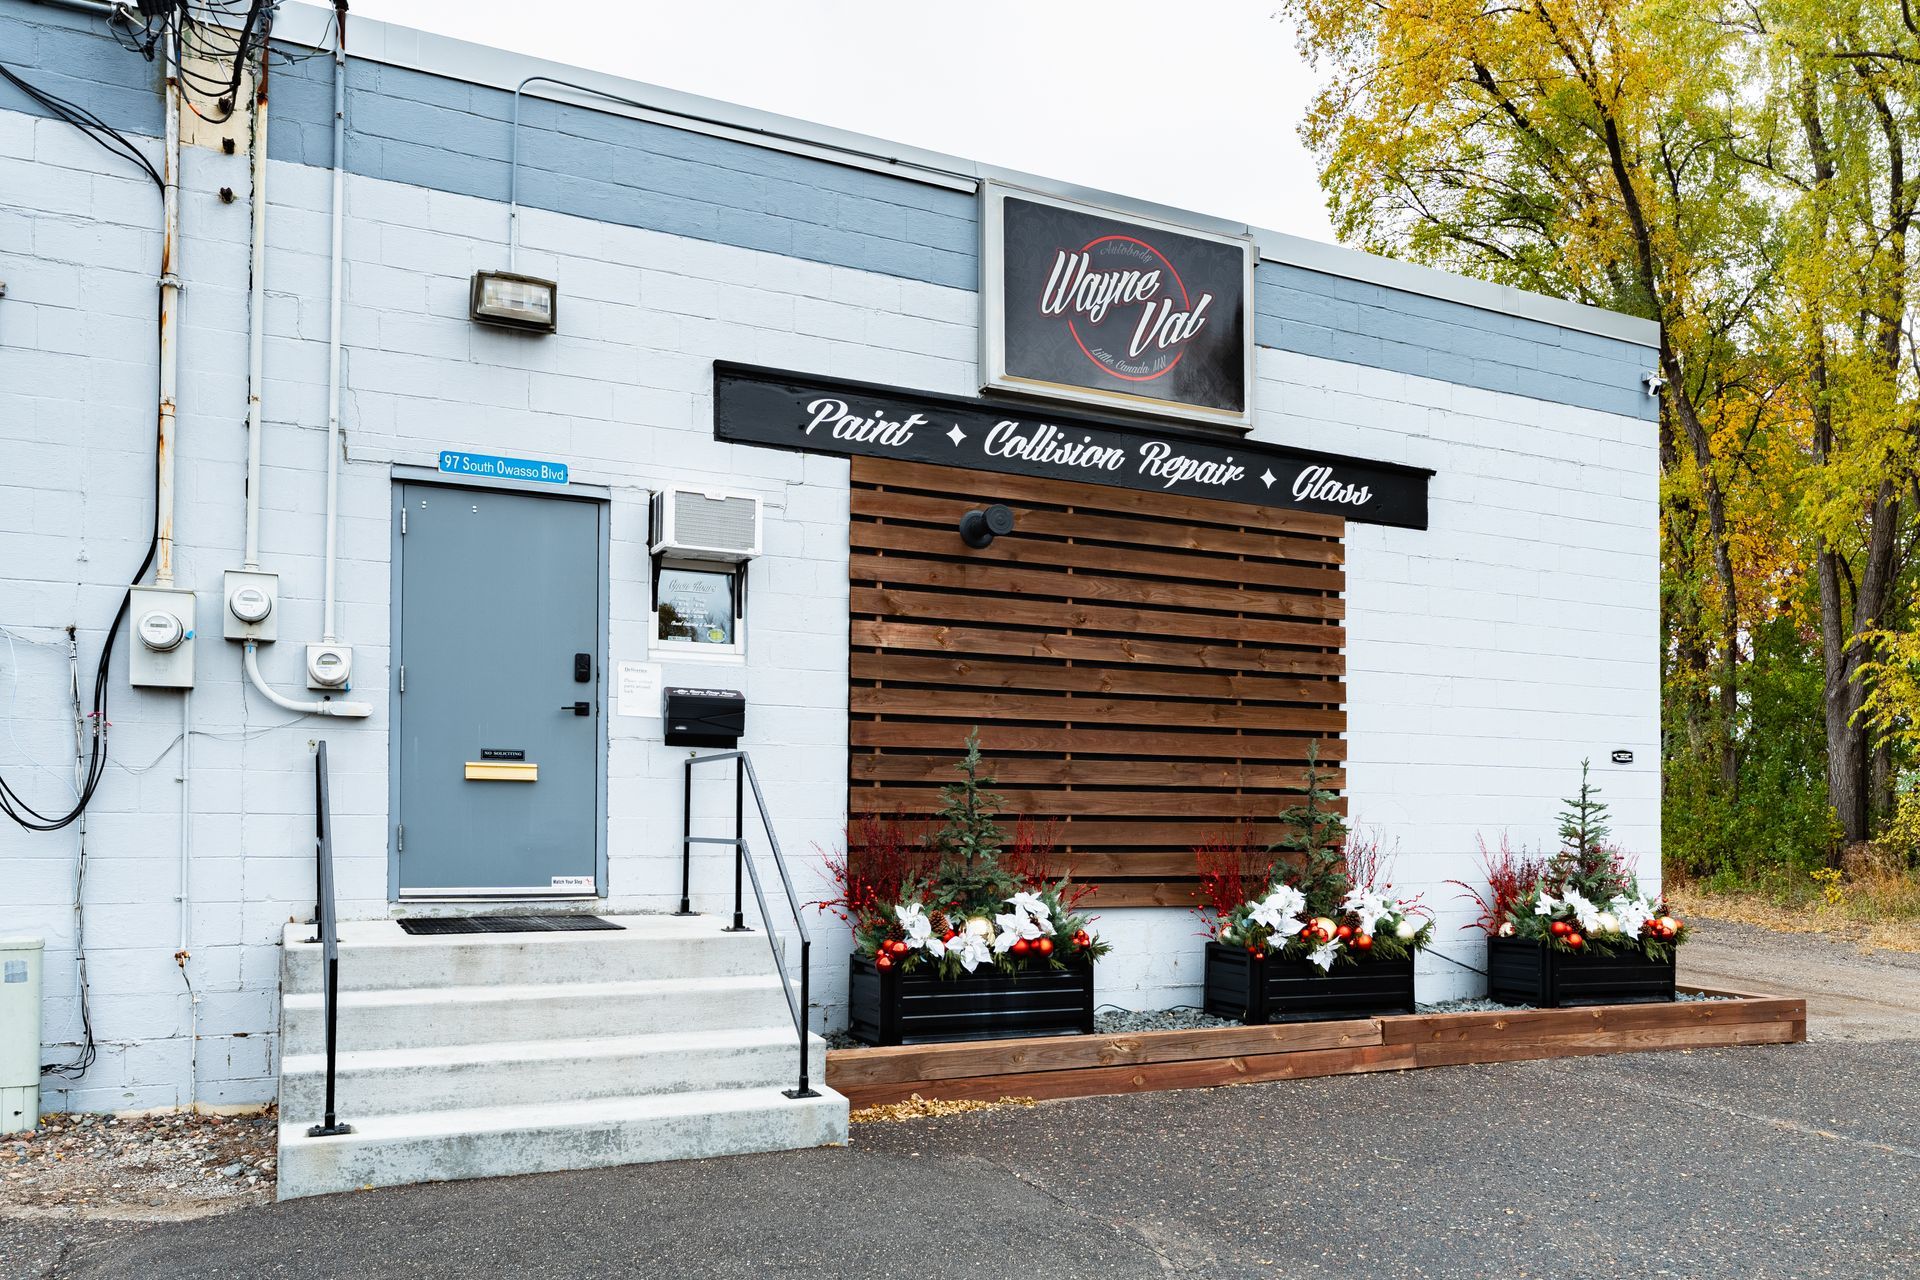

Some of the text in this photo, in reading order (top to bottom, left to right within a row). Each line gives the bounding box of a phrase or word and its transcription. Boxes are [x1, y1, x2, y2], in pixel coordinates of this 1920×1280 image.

[1100, 241, 1153, 263] Autobody
[1041, 250, 1160, 322] Wayne
[1129, 293, 1212, 358] Val
[1091, 348, 1166, 374] Little Canada MN
[805, 398, 1374, 506] Paint Collision Repair Glass
[444, 454, 564, 480] 97 South Owasso Blvd
[668, 579, 690, 592] Open
